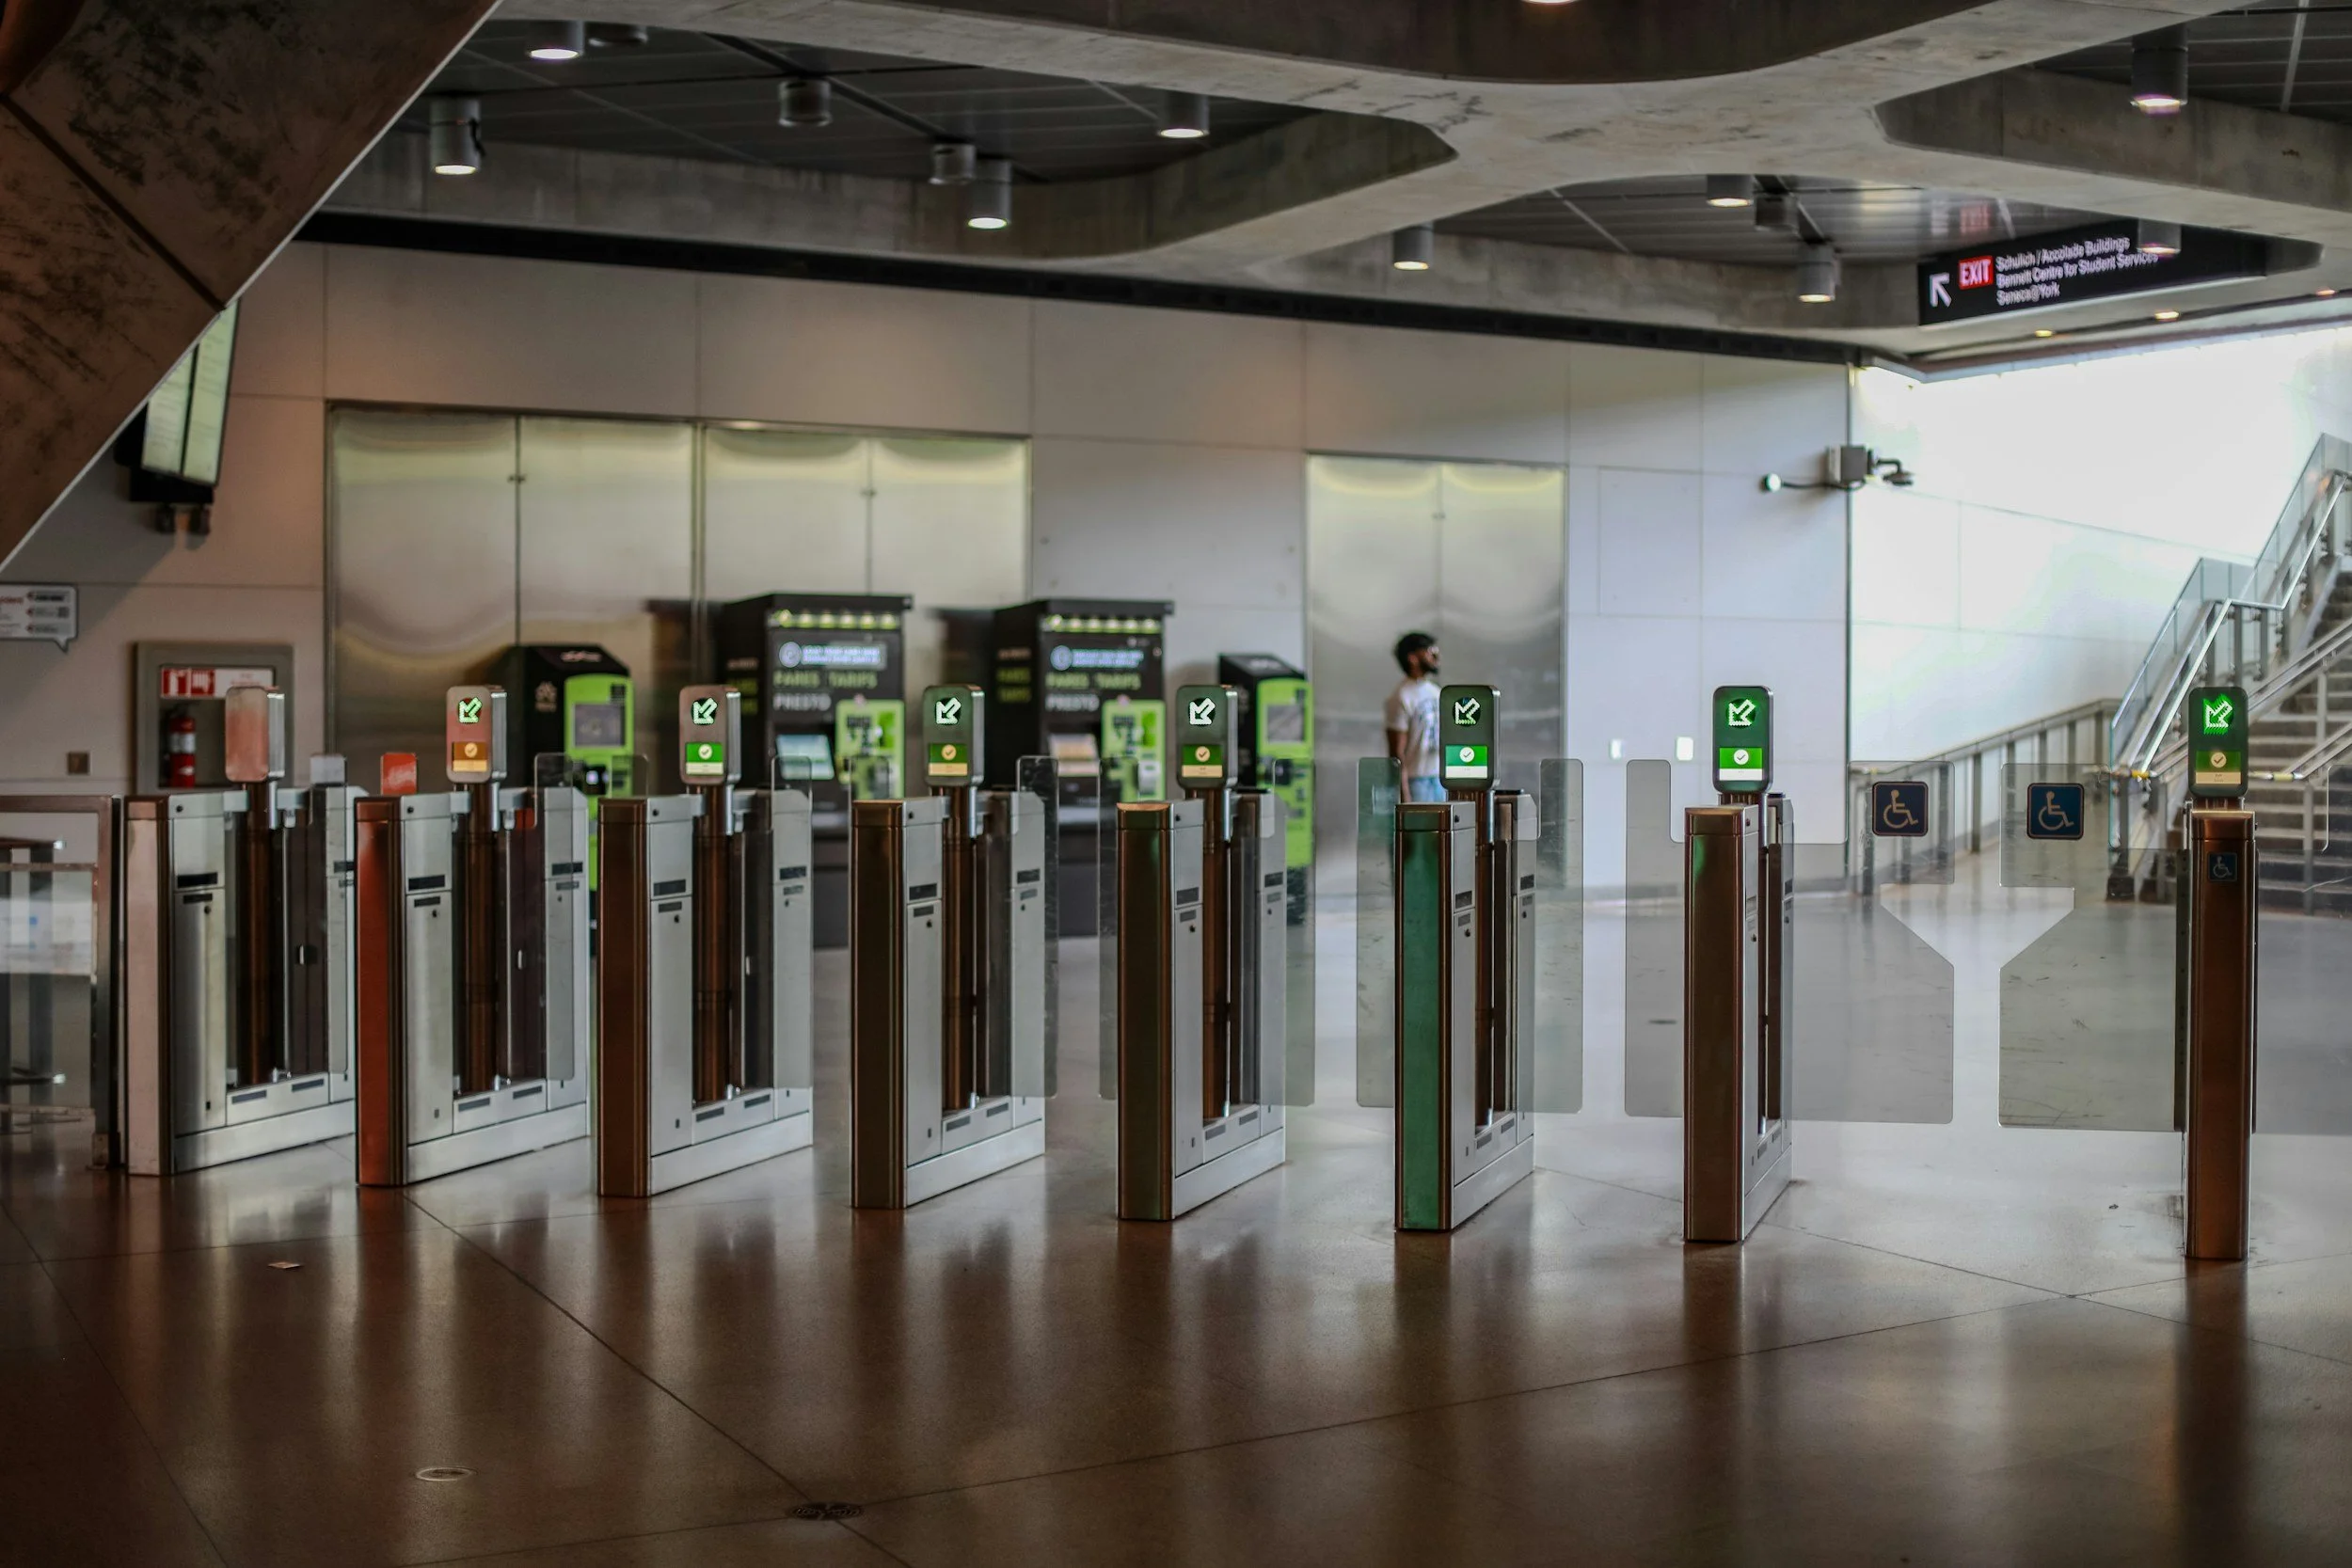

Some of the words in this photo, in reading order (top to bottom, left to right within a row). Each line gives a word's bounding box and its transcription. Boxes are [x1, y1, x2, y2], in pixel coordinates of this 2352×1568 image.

[1995, 253, 2035, 271] Schulich
[2041, 245, 2084, 263] Accolade
[2084, 237, 2130, 256] Buildings
[1995, 270, 2032, 289] Bennett
[2032, 266, 2063, 282] Centre
[2063, 262, 2077, 277] for
[2077, 256, 2117, 275] Student
[2116, 252, 2158, 269] Services
[1960, 259, 1991, 286] EXIT
